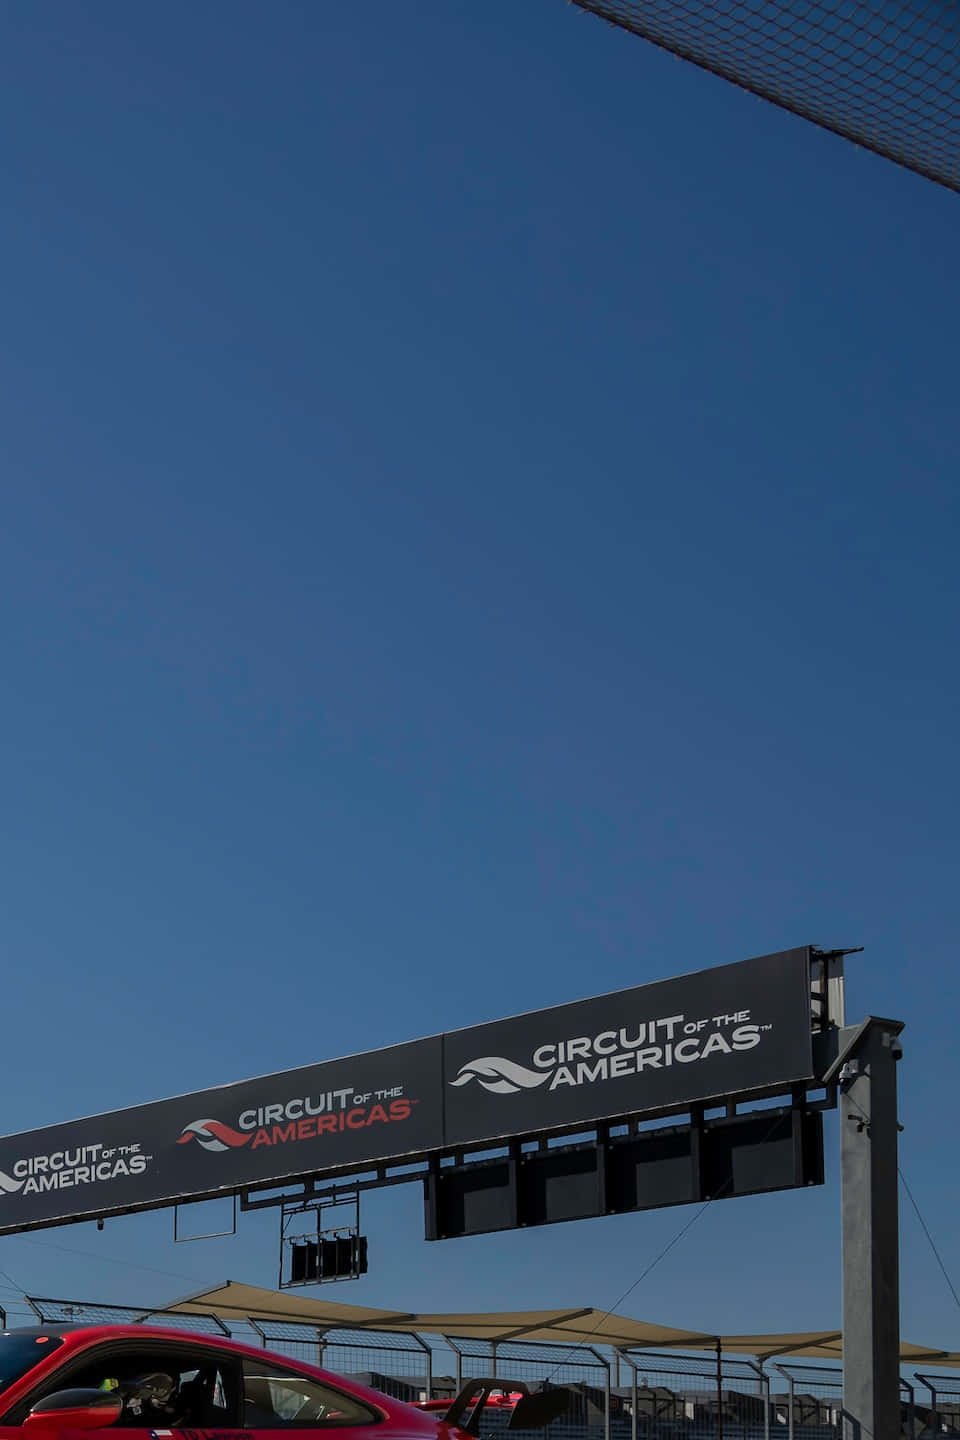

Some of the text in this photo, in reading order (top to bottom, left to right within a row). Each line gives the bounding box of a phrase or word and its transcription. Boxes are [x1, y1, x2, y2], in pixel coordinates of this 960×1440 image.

[533, 1010, 751, 1068] CIRCUIT OF THE
[548, 1024, 762, 1091] AMERICAS
[238, 1086, 404, 1130] CIRCUIT OF THE
[251, 1099, 412, 1150] AMERICAS
[13, 1144, 141, 1178] CIRCUIT OF THE
[22, 1155, 148, 1196] AMERICAS
